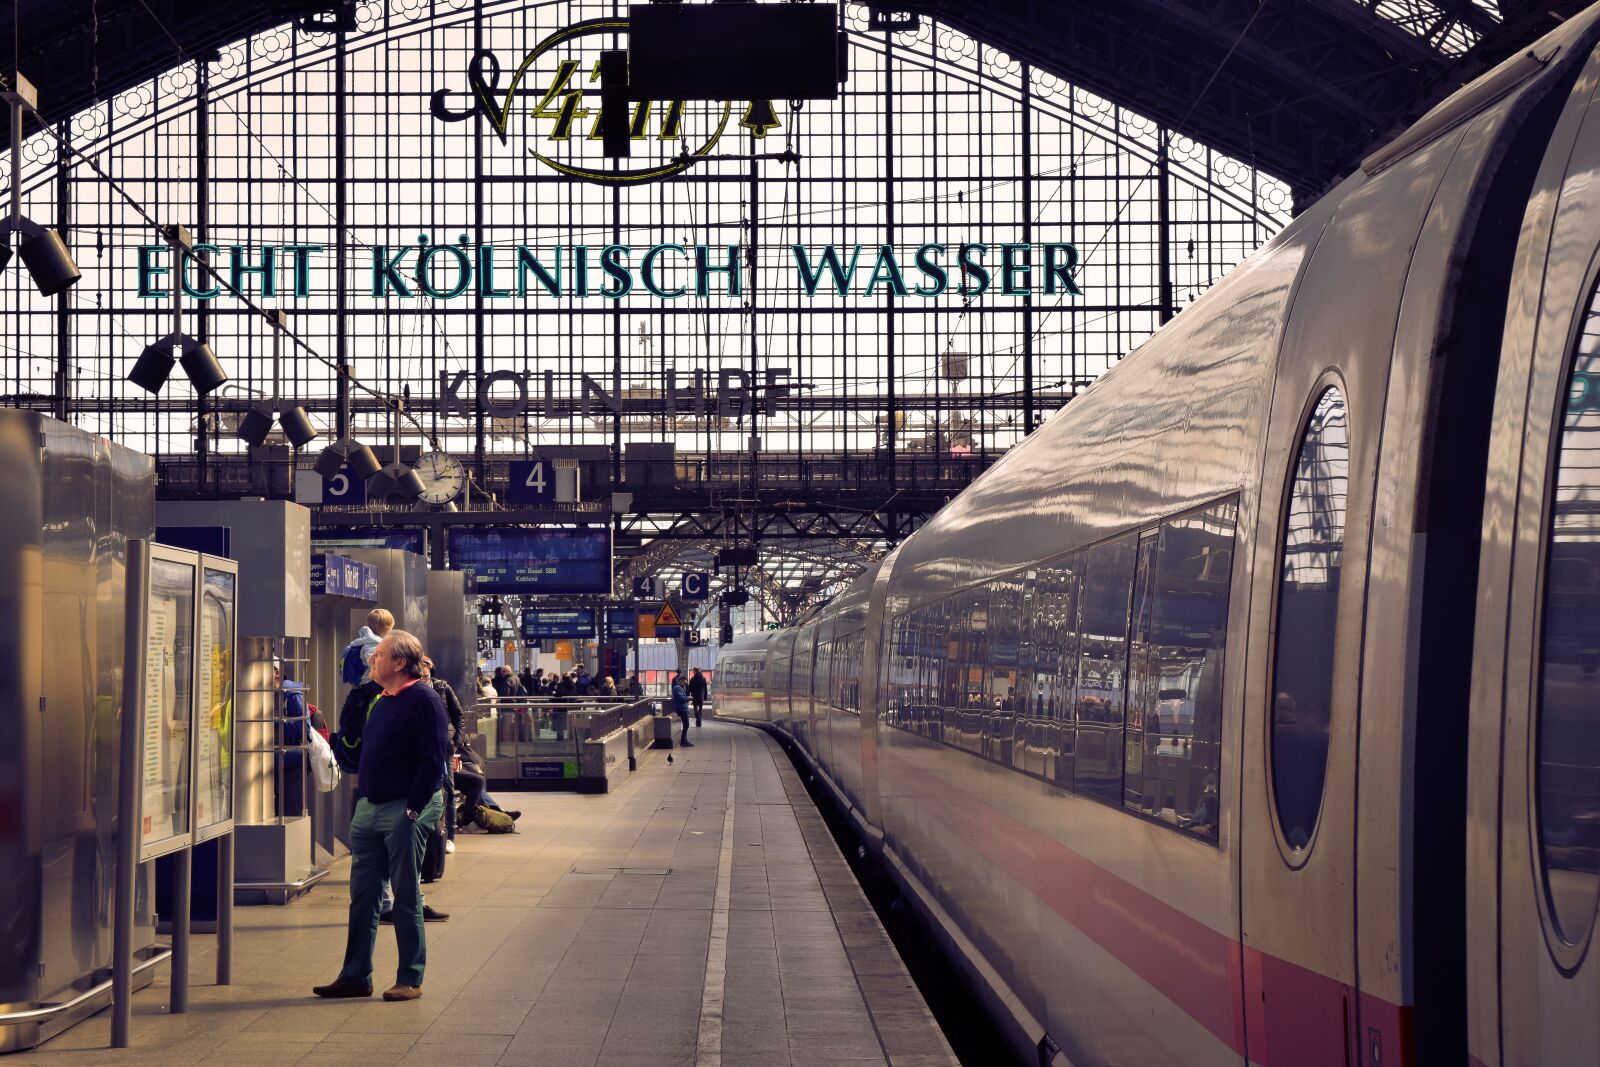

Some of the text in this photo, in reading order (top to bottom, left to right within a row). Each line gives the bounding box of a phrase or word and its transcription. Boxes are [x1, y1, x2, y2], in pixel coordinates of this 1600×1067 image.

[137, 233, 1083, 300] ECHT KÖLNISCH WASSER
[439, 367, 792, 420] KÖLN HBF
[525, 462, 547, 494] 4
[310, 579, 326, 587] eiger
[640, 576, 651, 592] 4
[685, 573, 701, 594] C
[689, 631, 699, 644] B
